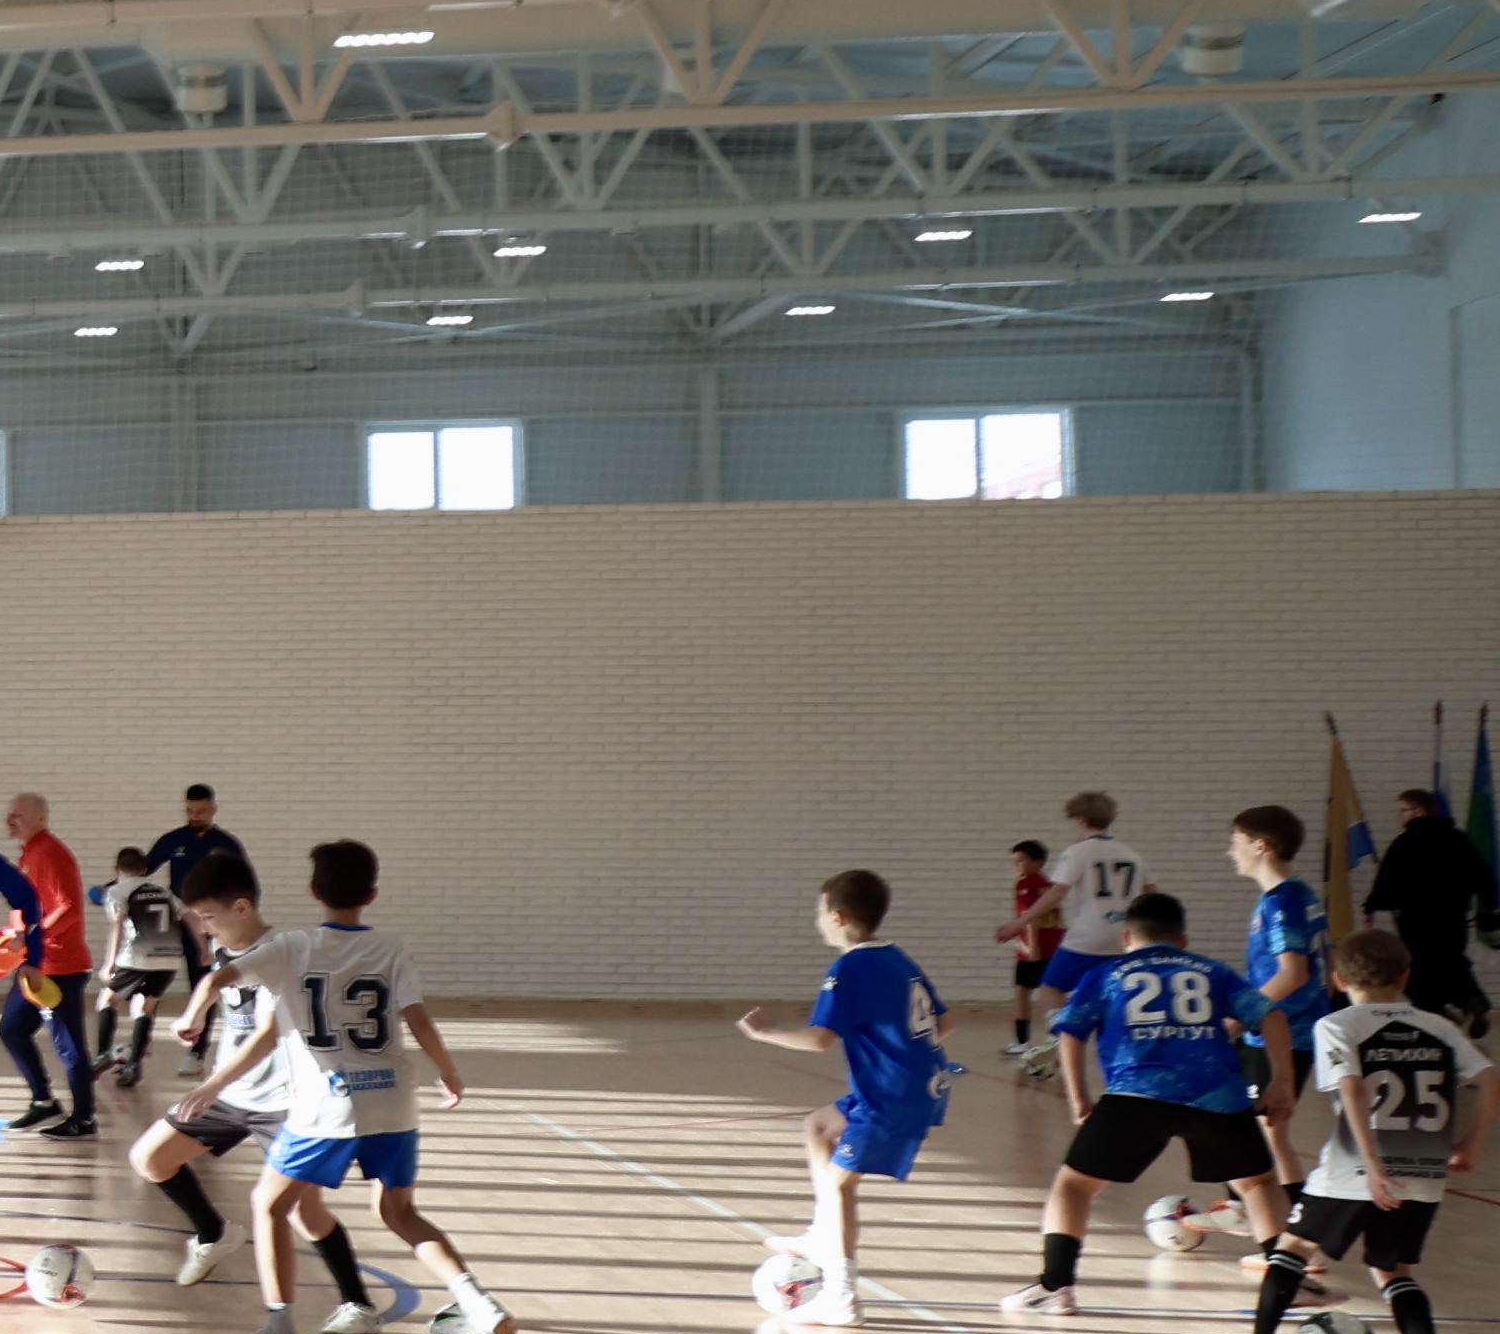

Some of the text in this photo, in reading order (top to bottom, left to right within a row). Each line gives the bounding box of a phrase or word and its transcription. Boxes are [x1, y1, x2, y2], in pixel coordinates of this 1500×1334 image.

[1094, 862, 1135, 898] 17
[147, 902, 170, 933] 7
[300, 972, 394, 1054] 13
[1122, 970, 1214, 1026] 28
[1131, 1025, 1217, 1041] СУРГУТ
[1362, 1070, 1450, 1132] 25
